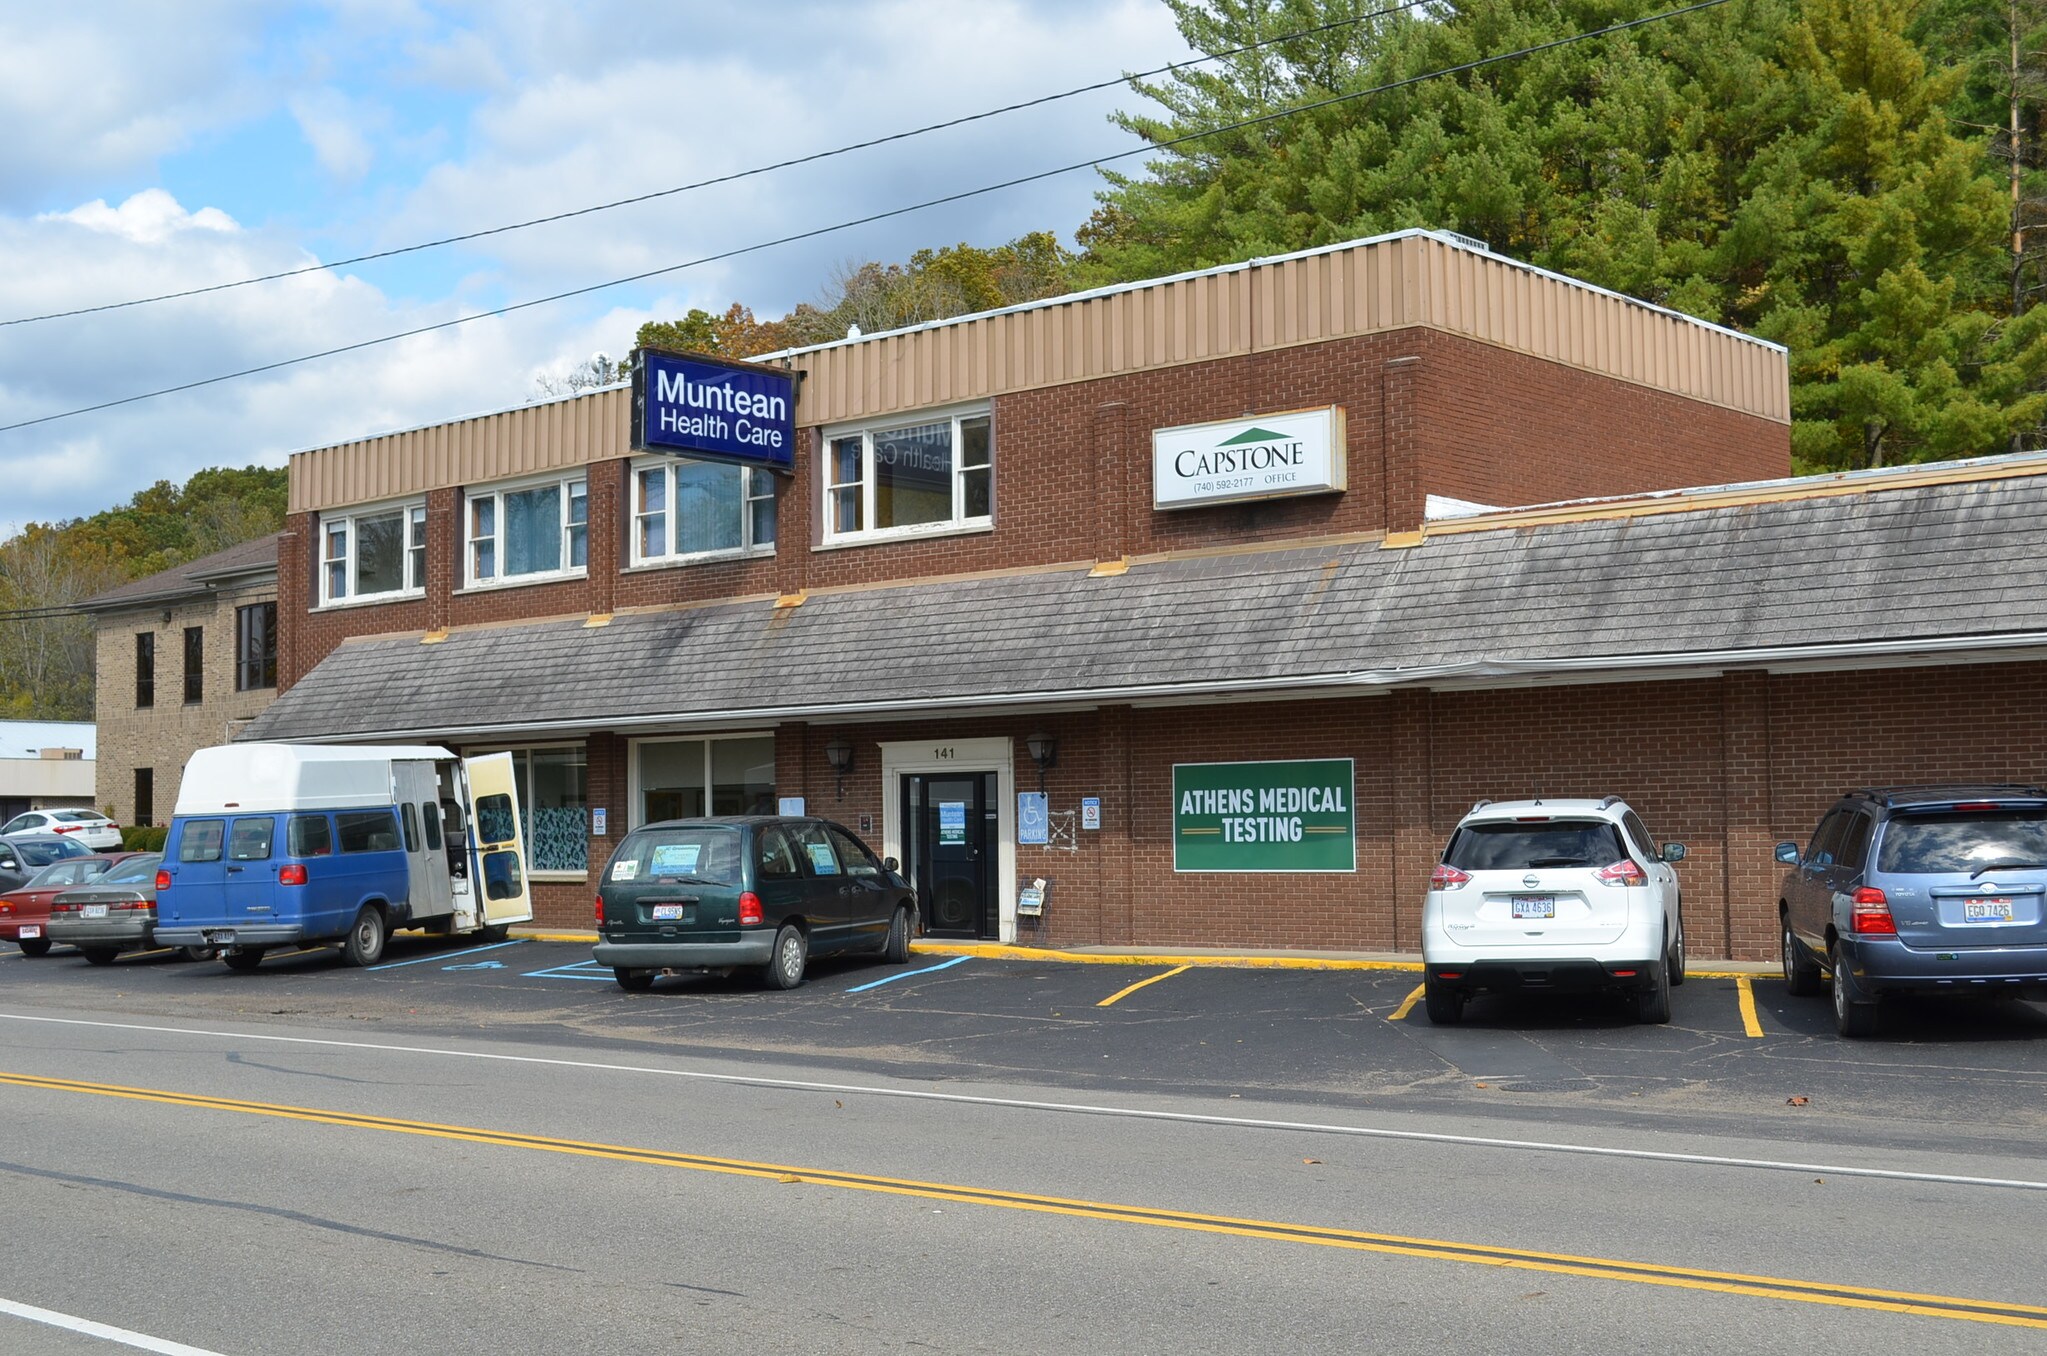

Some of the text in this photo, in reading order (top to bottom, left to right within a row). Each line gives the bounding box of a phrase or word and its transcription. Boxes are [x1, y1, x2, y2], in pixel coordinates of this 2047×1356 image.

[657, 369, 786, 422] Muntean
[660, 406, 783, 448] Health Care
[1174, 442, 1304, 478] CAPSTONE
[1193, 472, 1297, 495] (740) 592-2177 OFFICE
[934, 747, 954, 760] 141
[1180, 786, 1347, 815] ATHENS MEDICAL
[1020, 828, 1046, 840] PARKING
[1221, 817, 1303, 843] TESTING
[1514, 902, 1552, 914] GXA 4636
[1987, 904, 2010, 916] 7426
